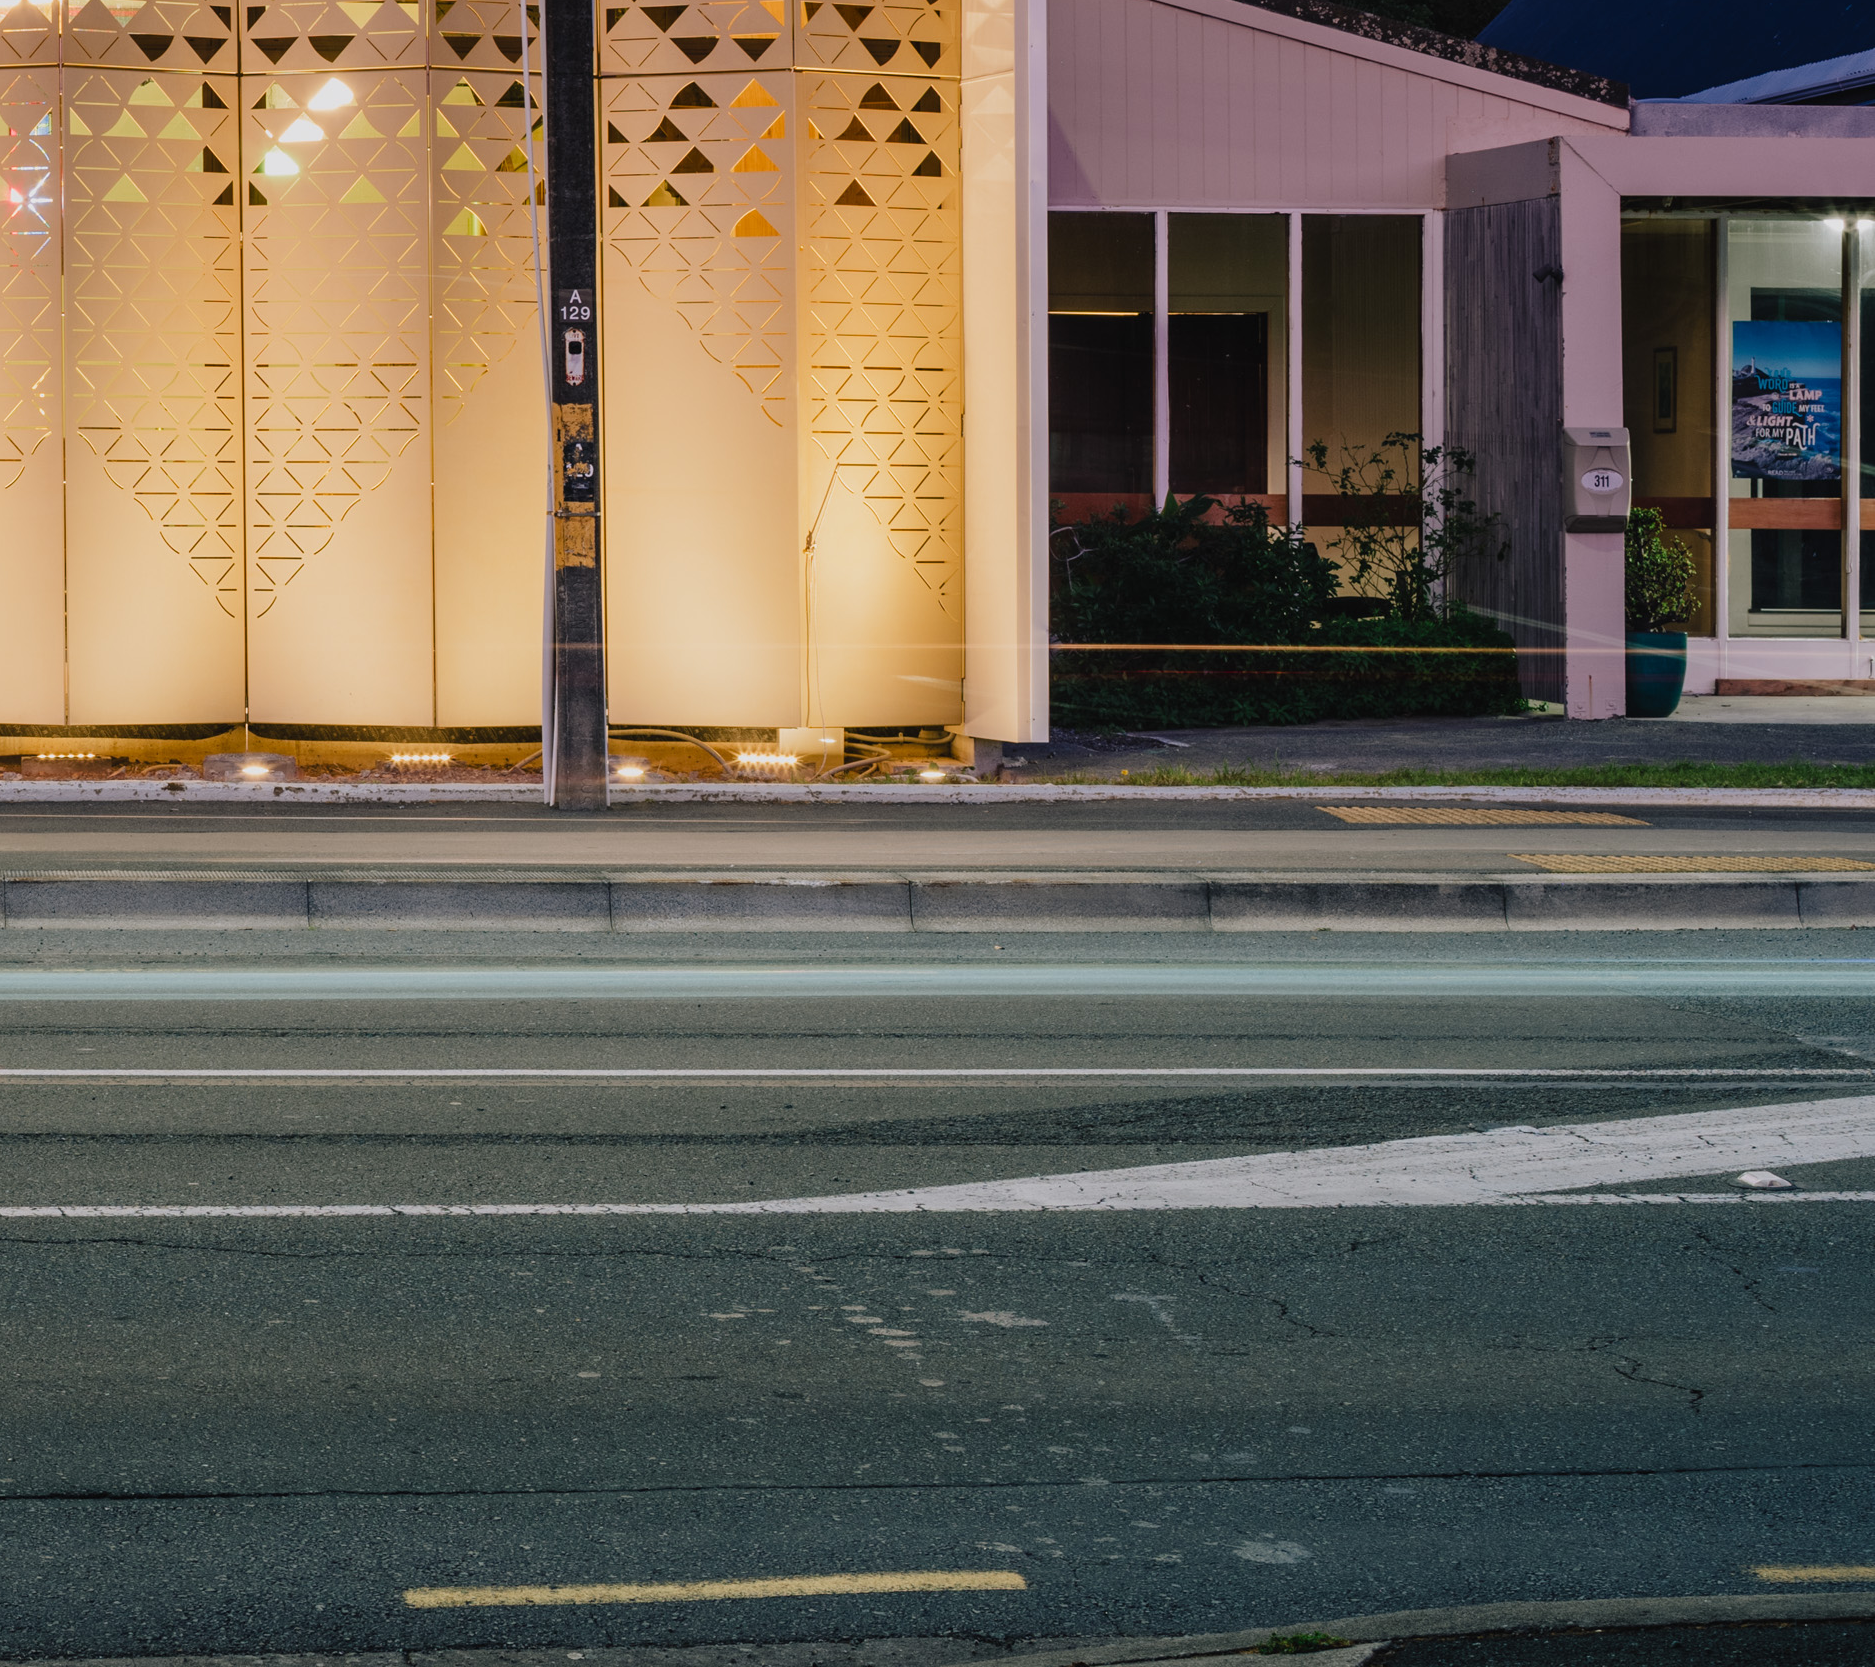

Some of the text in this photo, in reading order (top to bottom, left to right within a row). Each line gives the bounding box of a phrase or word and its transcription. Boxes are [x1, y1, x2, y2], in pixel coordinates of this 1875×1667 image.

[569, 289, 582, 304] A
[560, 306, 591, 320] 129
[1754, 374, 1789, 393] WORD
[1789, 389, 1823, 401] LAMP
[1762, 403, 1772, 412] TO
[1772, 398, 1803, 417] GUIDE
[1798, 404, 1809, 413] MY
[1756, 416, 1794, 427] LIGHT
[1755, 422, 1821, 451] FOR MY PATH
[1594, 474, 1610, 488] 311
